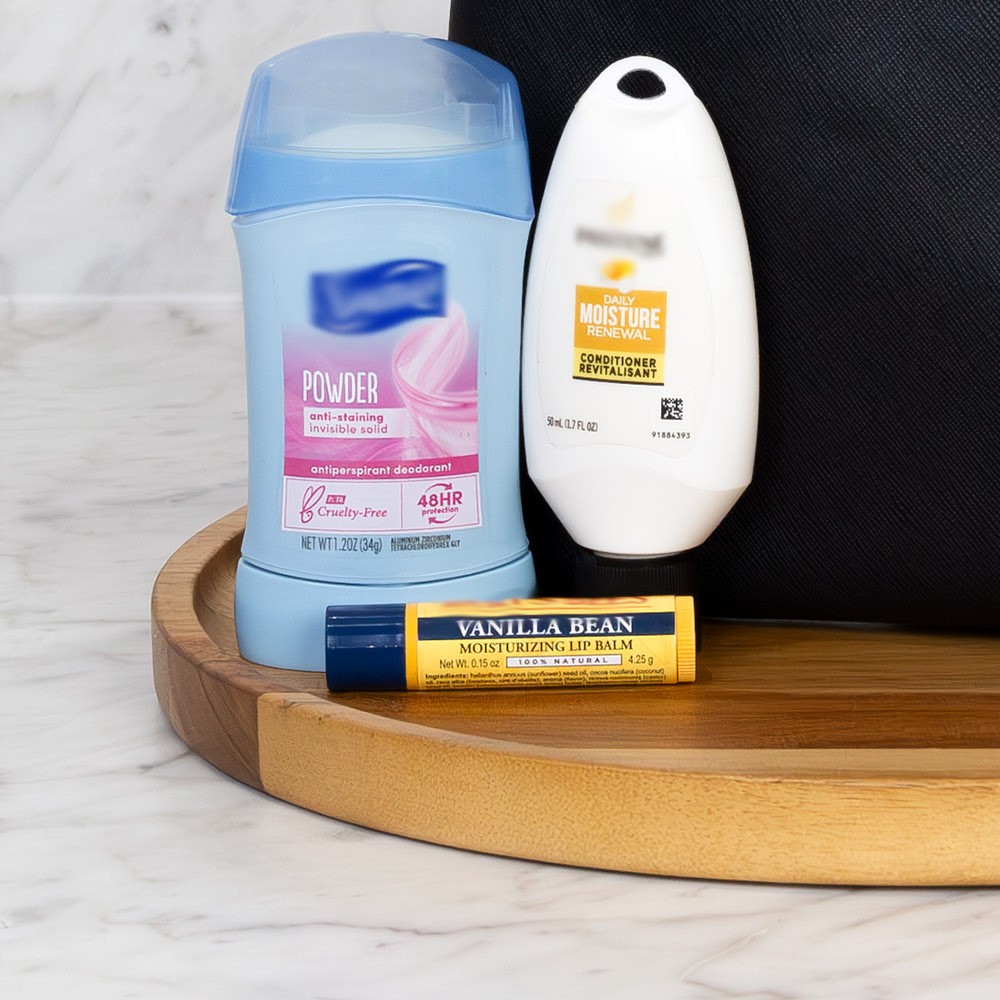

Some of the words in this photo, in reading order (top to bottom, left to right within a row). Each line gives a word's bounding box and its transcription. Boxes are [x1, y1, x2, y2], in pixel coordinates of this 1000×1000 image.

[603, 294, 636, 306] DAILY
[579, 302, 661, 329] MOISTURE
[586, 325, 651, 341] RENEWAL
[580, 352, 657, 368] CONDITIONER
[579, 363, 657, 378] REVITALISANT
[302, 369, 378, 404] POWDER
[309, 411, 384, 424] anti-staining
[546, 416, 554, 427] 50
[554, 418, 563, 428] mL
[577, 420, 586, 431] FL
[309, 424, 357, 434] invisible
[360, 424, 388, 434] solid
[651, 431, 691, 439] 91884393
[310, 464, 391, 477] antiperspirant
[393, 462, 452, 475] deodorant
[417, 491, 463, 508] 48HR
[317, 506, 388, 520] Cruelty-Free
[421, 506, 459, 517] protection
[301, 536, 317, 550] NET
[359, 537, 383, 554] (34g)
[456, 617, 563, 637] VANILLA
[568, 616, 634, 635] BEAN
[459, 641, 566, 654] MOISTURIZING
[569, 640, 591, 651] LIP
[595, 639, 633, 651] BALM
[439, 659, 454, 669] Net
[456, 658, 469, 669] Wt.
[471, 658, 489, 668] 0.15
[489, 659, 500, 668] oz
[553, 657, 609, 665] NATURAL
[628, 654, 647, 665] 4.25
[648, 656, 654, 666] g
[425, 671, 469, 680] Ingredients:
